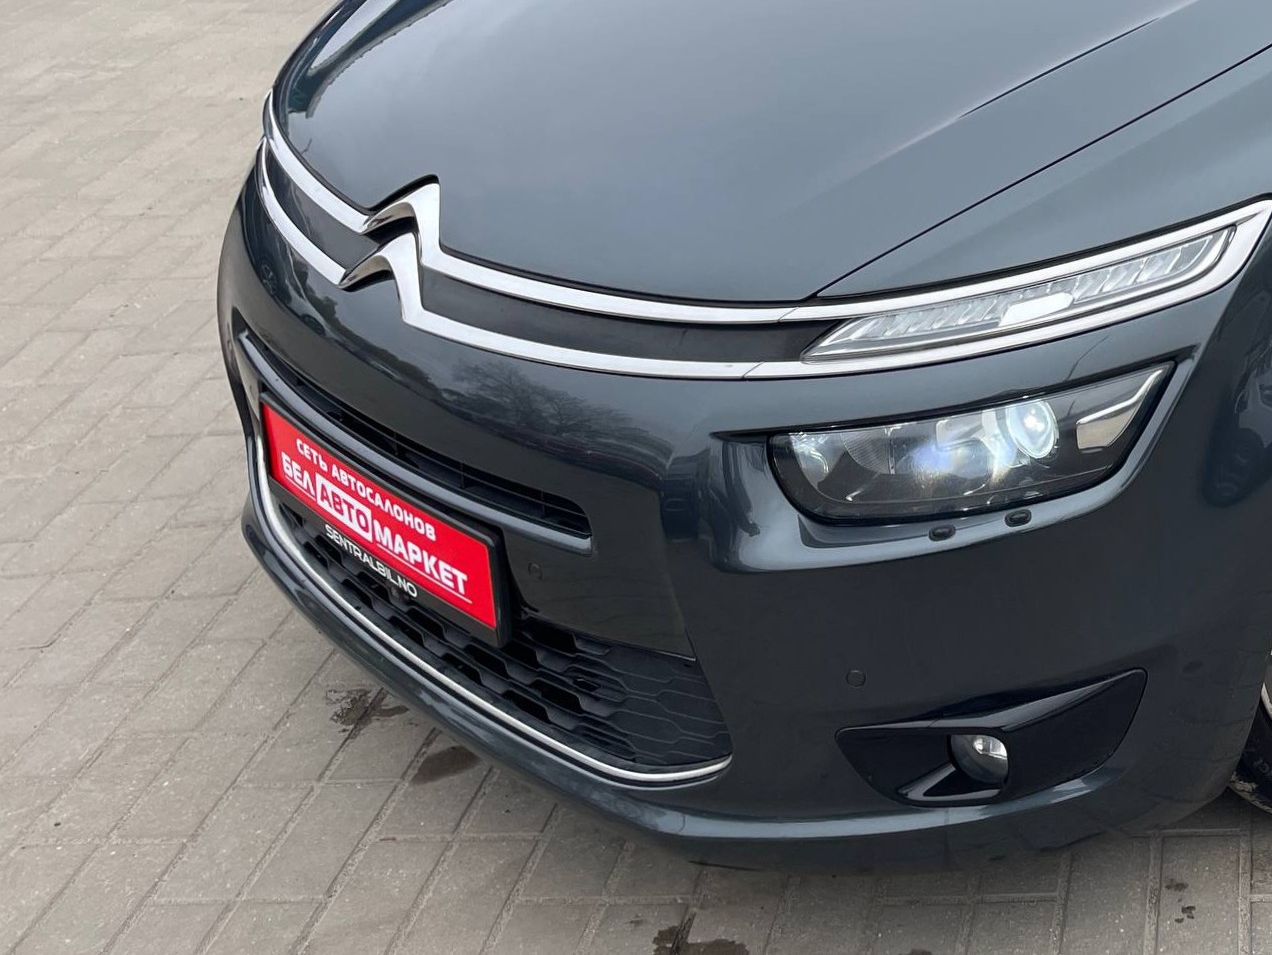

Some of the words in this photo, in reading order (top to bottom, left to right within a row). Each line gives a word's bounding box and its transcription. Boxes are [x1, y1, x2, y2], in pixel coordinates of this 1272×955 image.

[281, 451, 316, 496] БЕЛ
[318, 482, 371, 533] АВТО
[373, 519, 468, 595] МАРКЕТ
[296, 438, 328, 472] СЕТЬ
[331, 463, 436, 542] АВТОСАЛОНОВ
